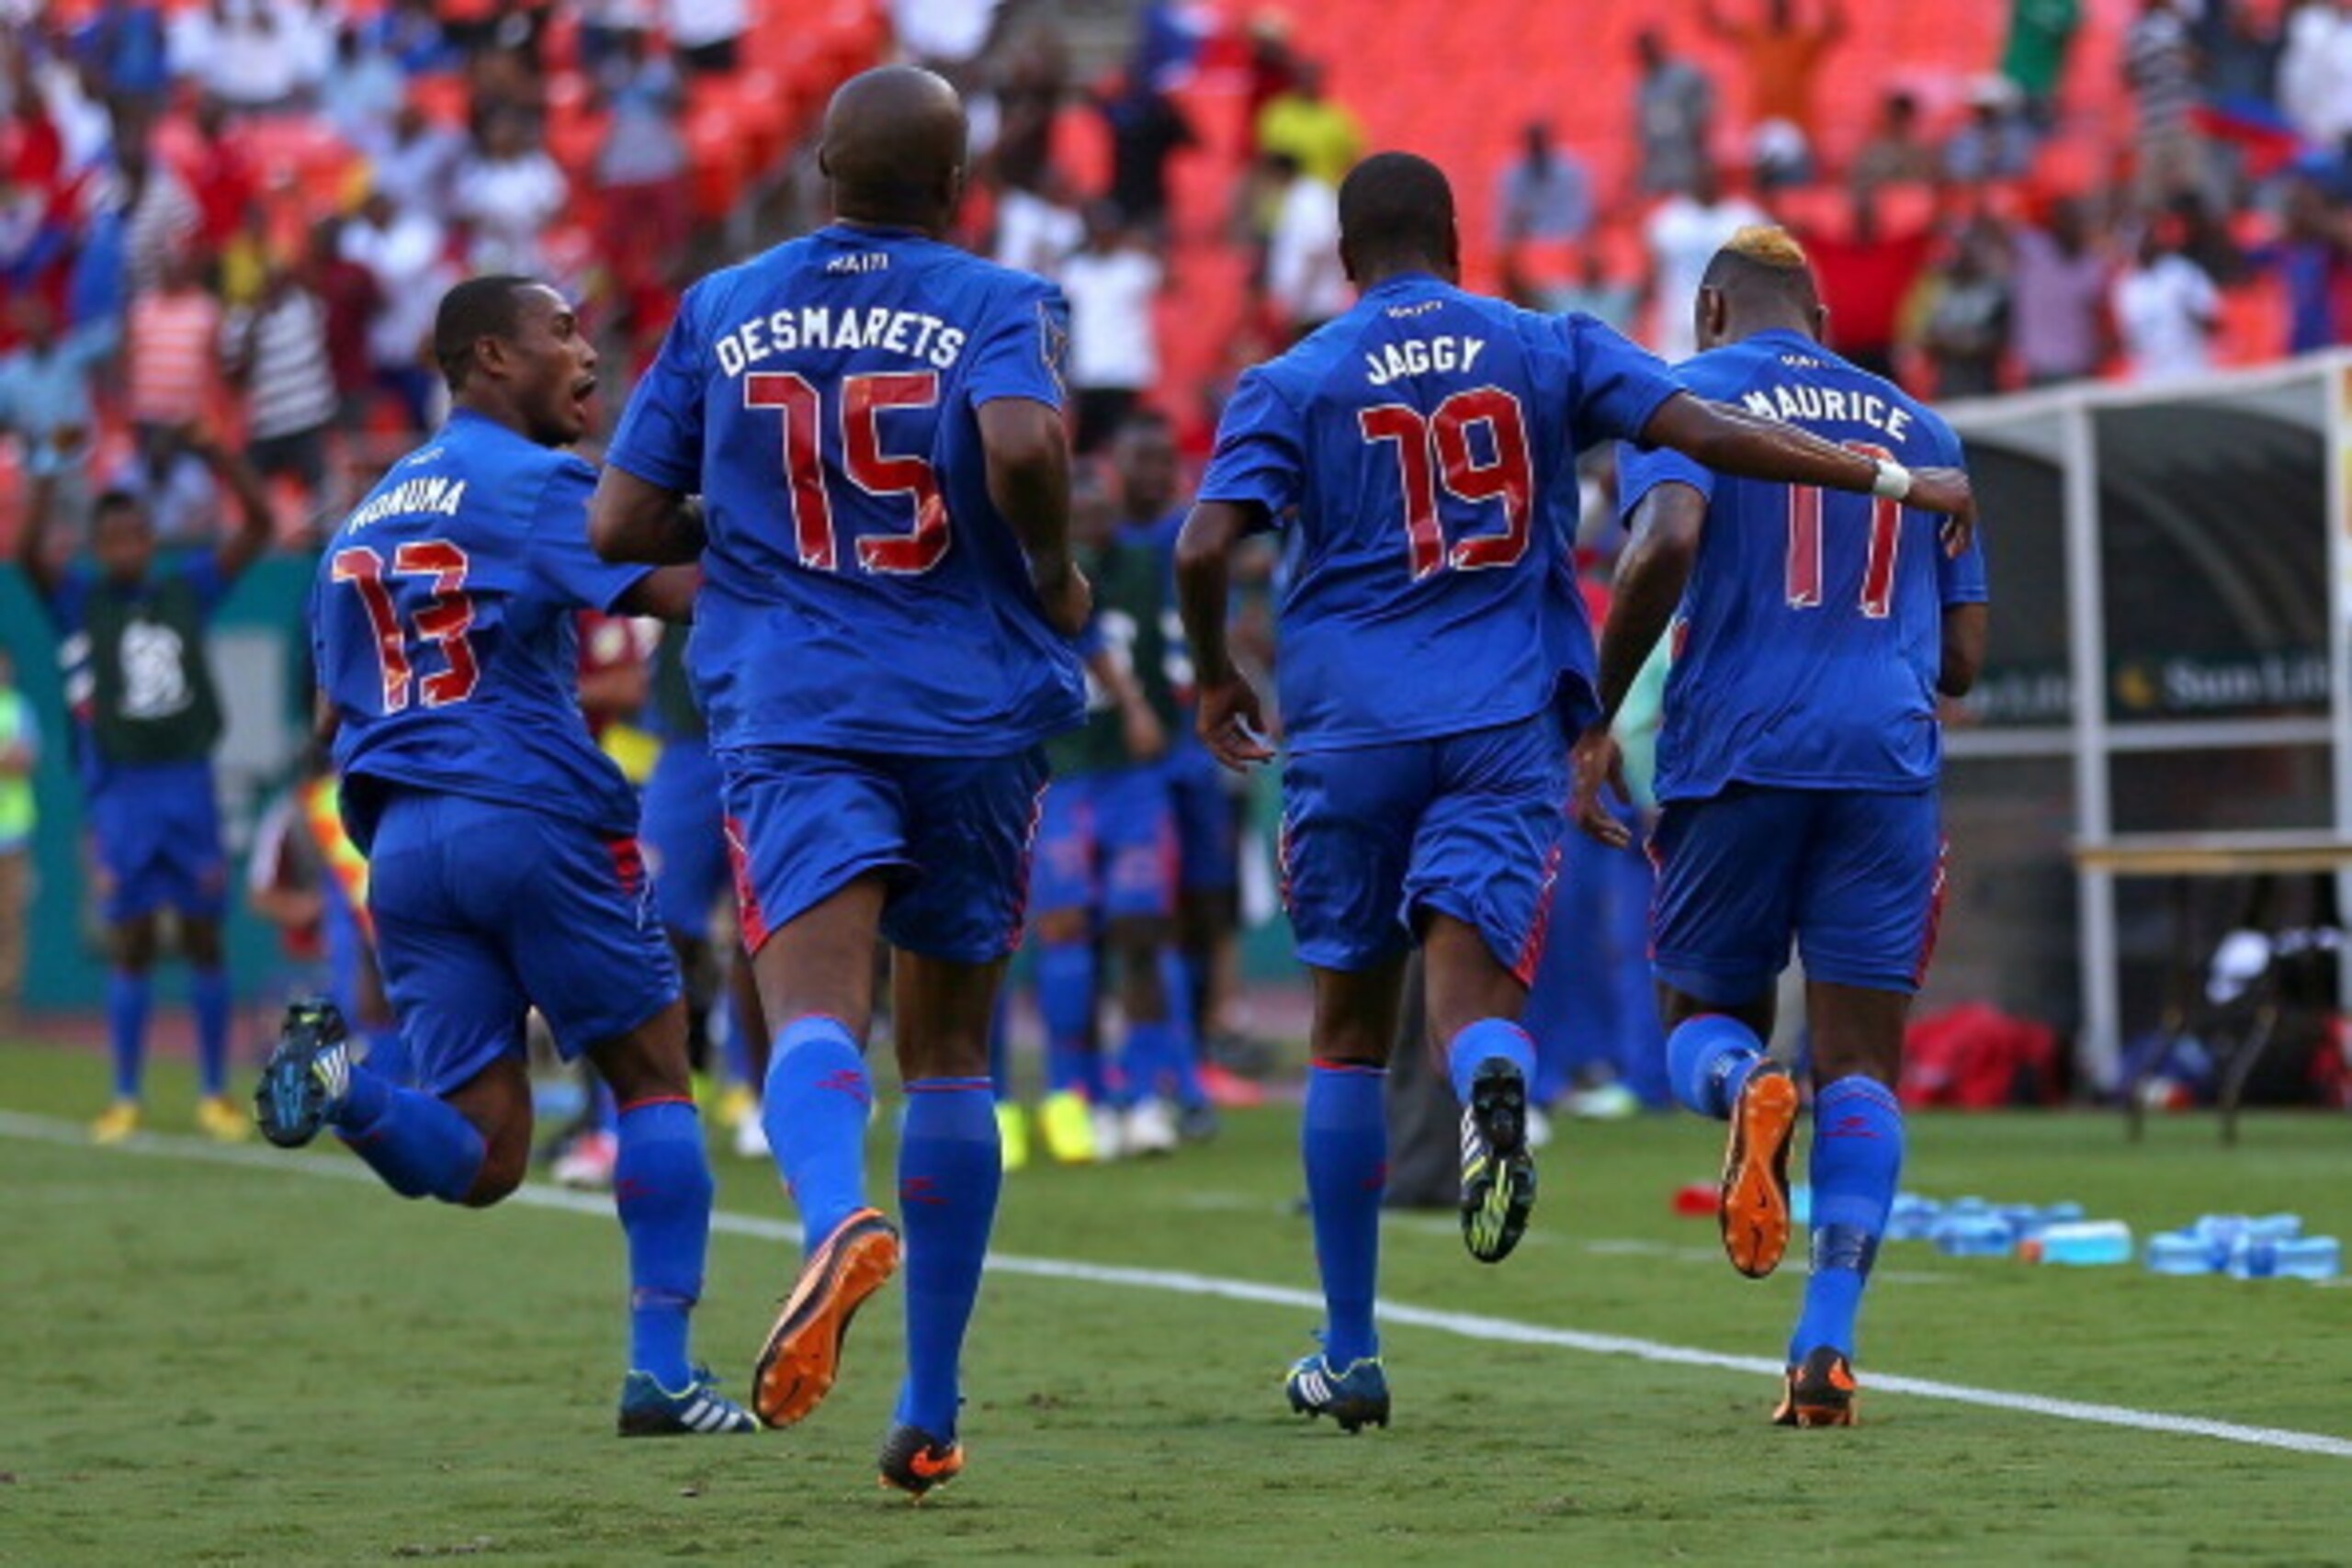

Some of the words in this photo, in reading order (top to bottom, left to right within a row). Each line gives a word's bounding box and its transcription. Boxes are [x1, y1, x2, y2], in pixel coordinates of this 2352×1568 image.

[715, 306, 966, 378] DESMARETS
[1365, 334, 1486, 385] JAGGY
[744, 370, 951, 575] 15
[1741, 384, 1913, 444] MAURICE
[1357, 384, 1534, 583] 19
[332, 538, 480, 716] 13
